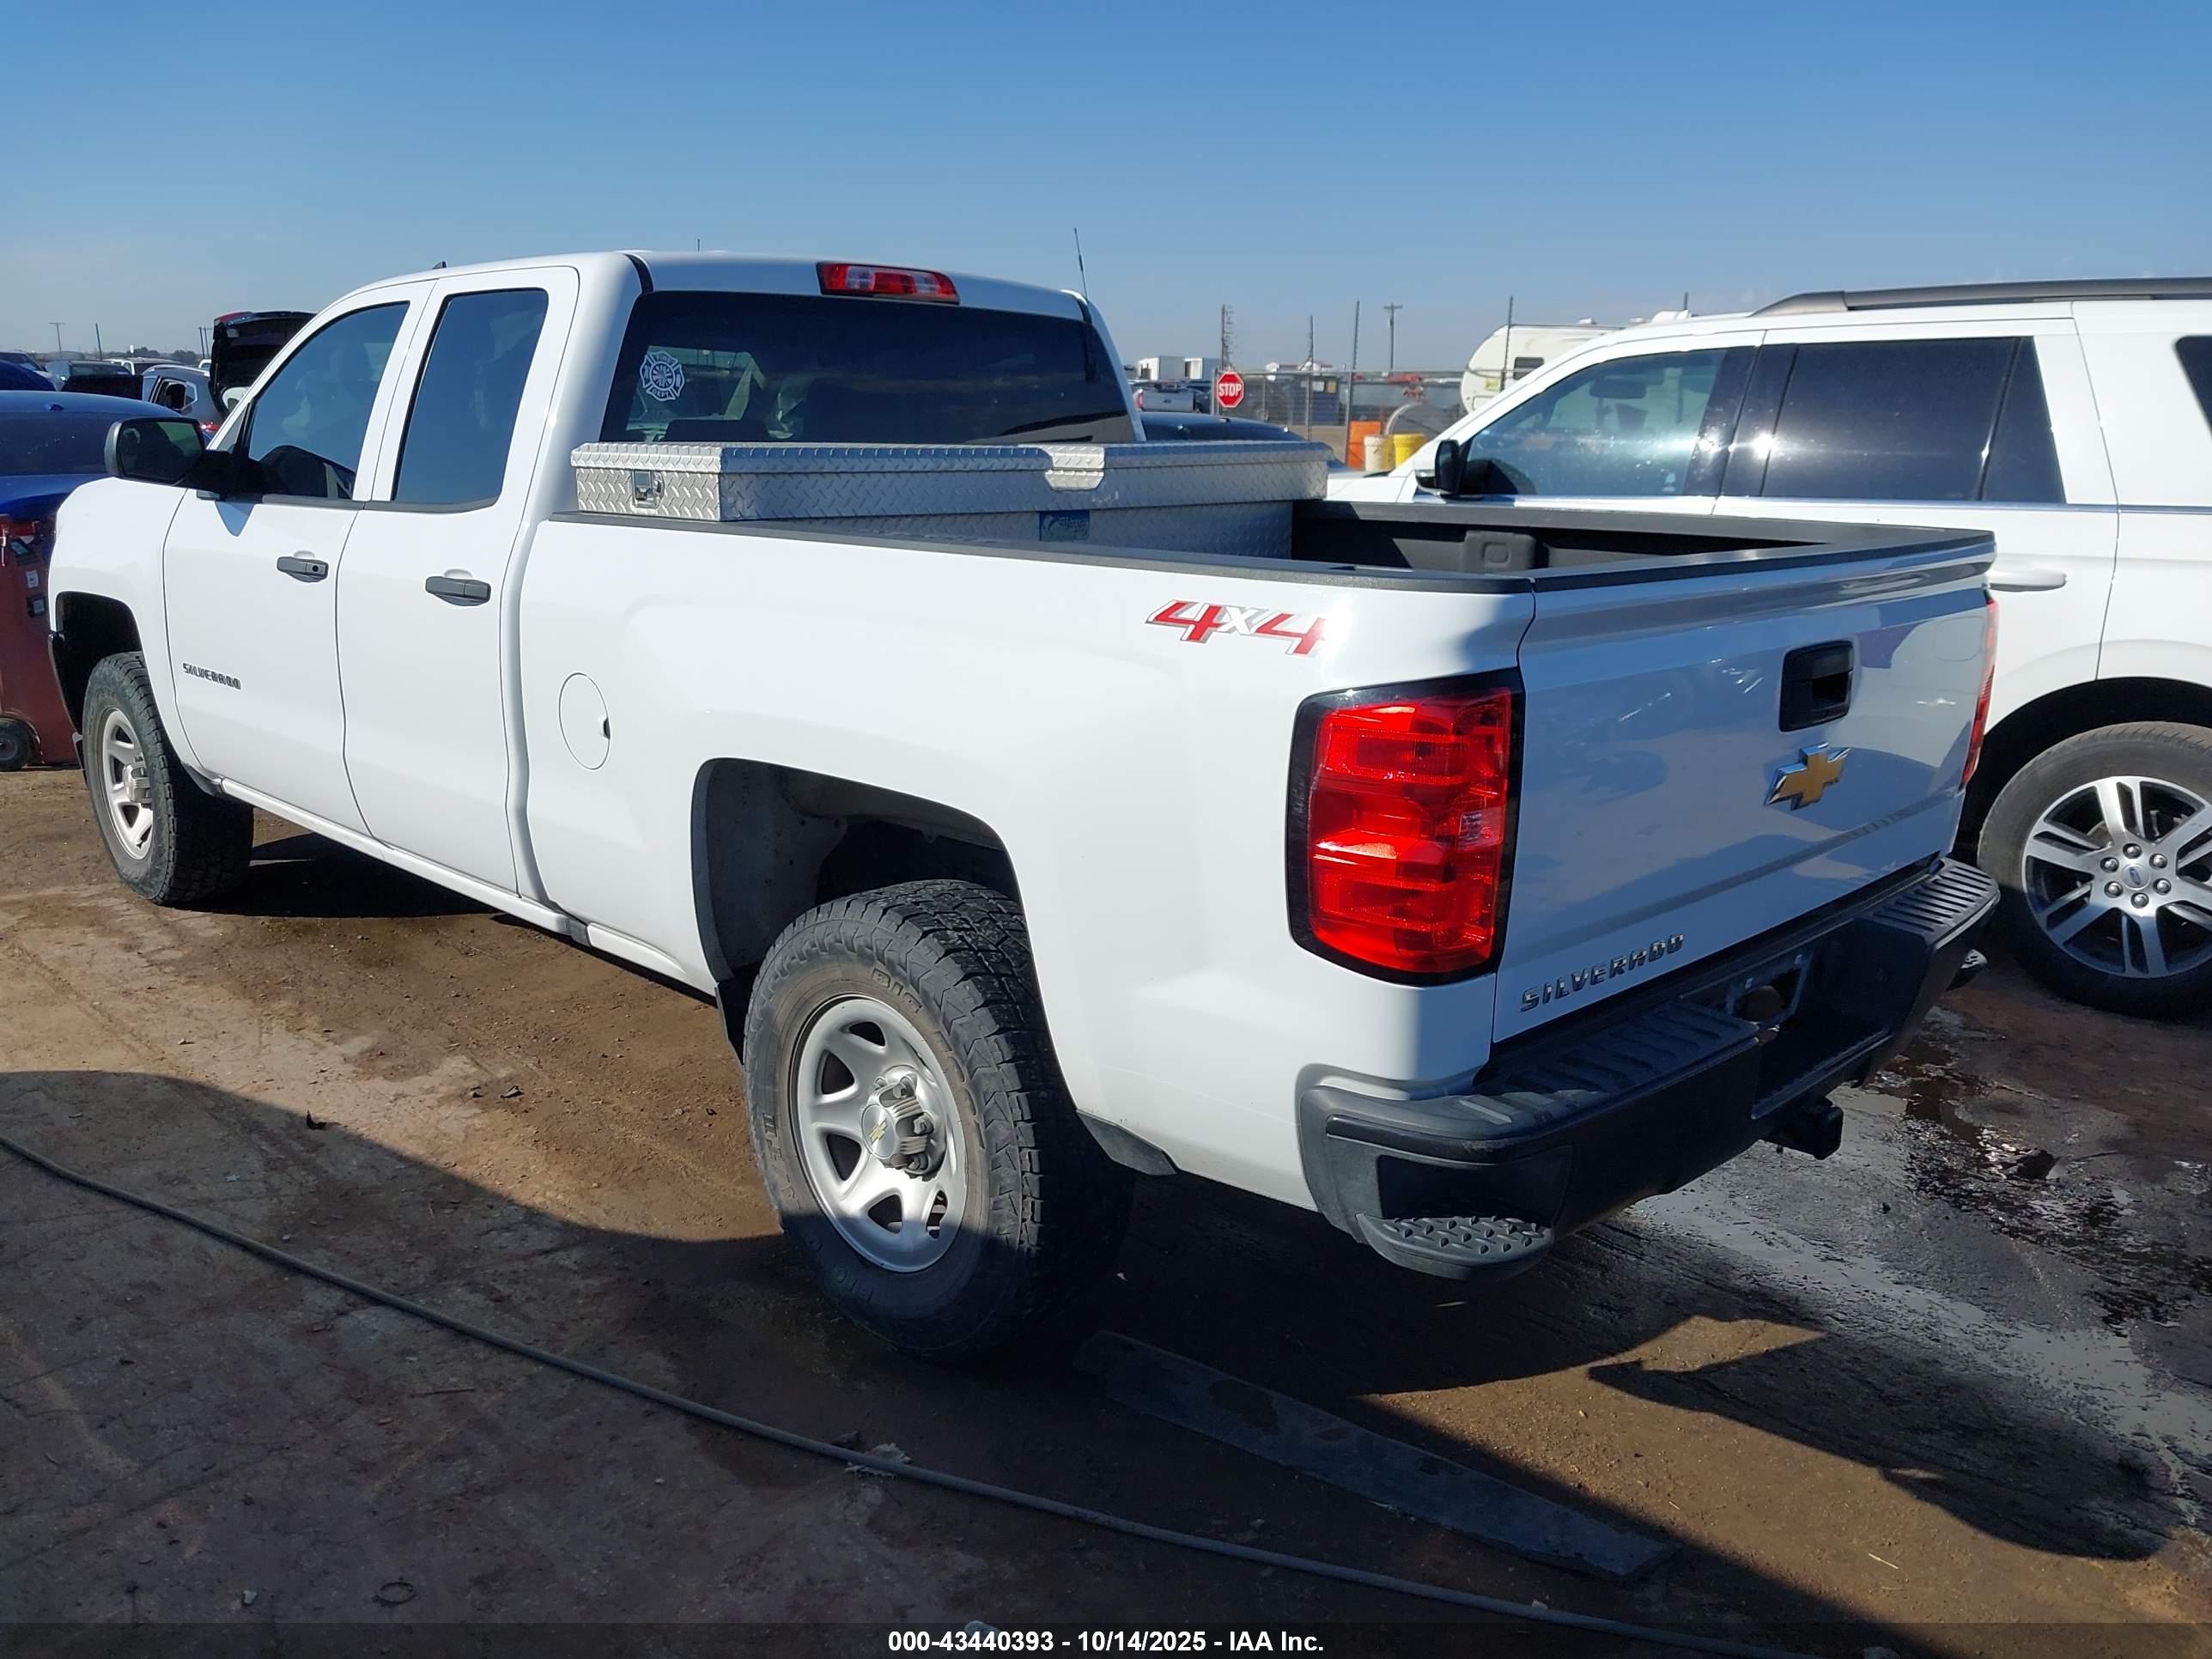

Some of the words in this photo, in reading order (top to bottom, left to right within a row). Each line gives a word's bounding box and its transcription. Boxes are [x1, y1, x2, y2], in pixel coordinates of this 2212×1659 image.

[1218, 383, 1242, 397] STOP
[182, 662, 241, 690] SILVERADO
[1521, 933, 1684, 1021] SILVERADO
